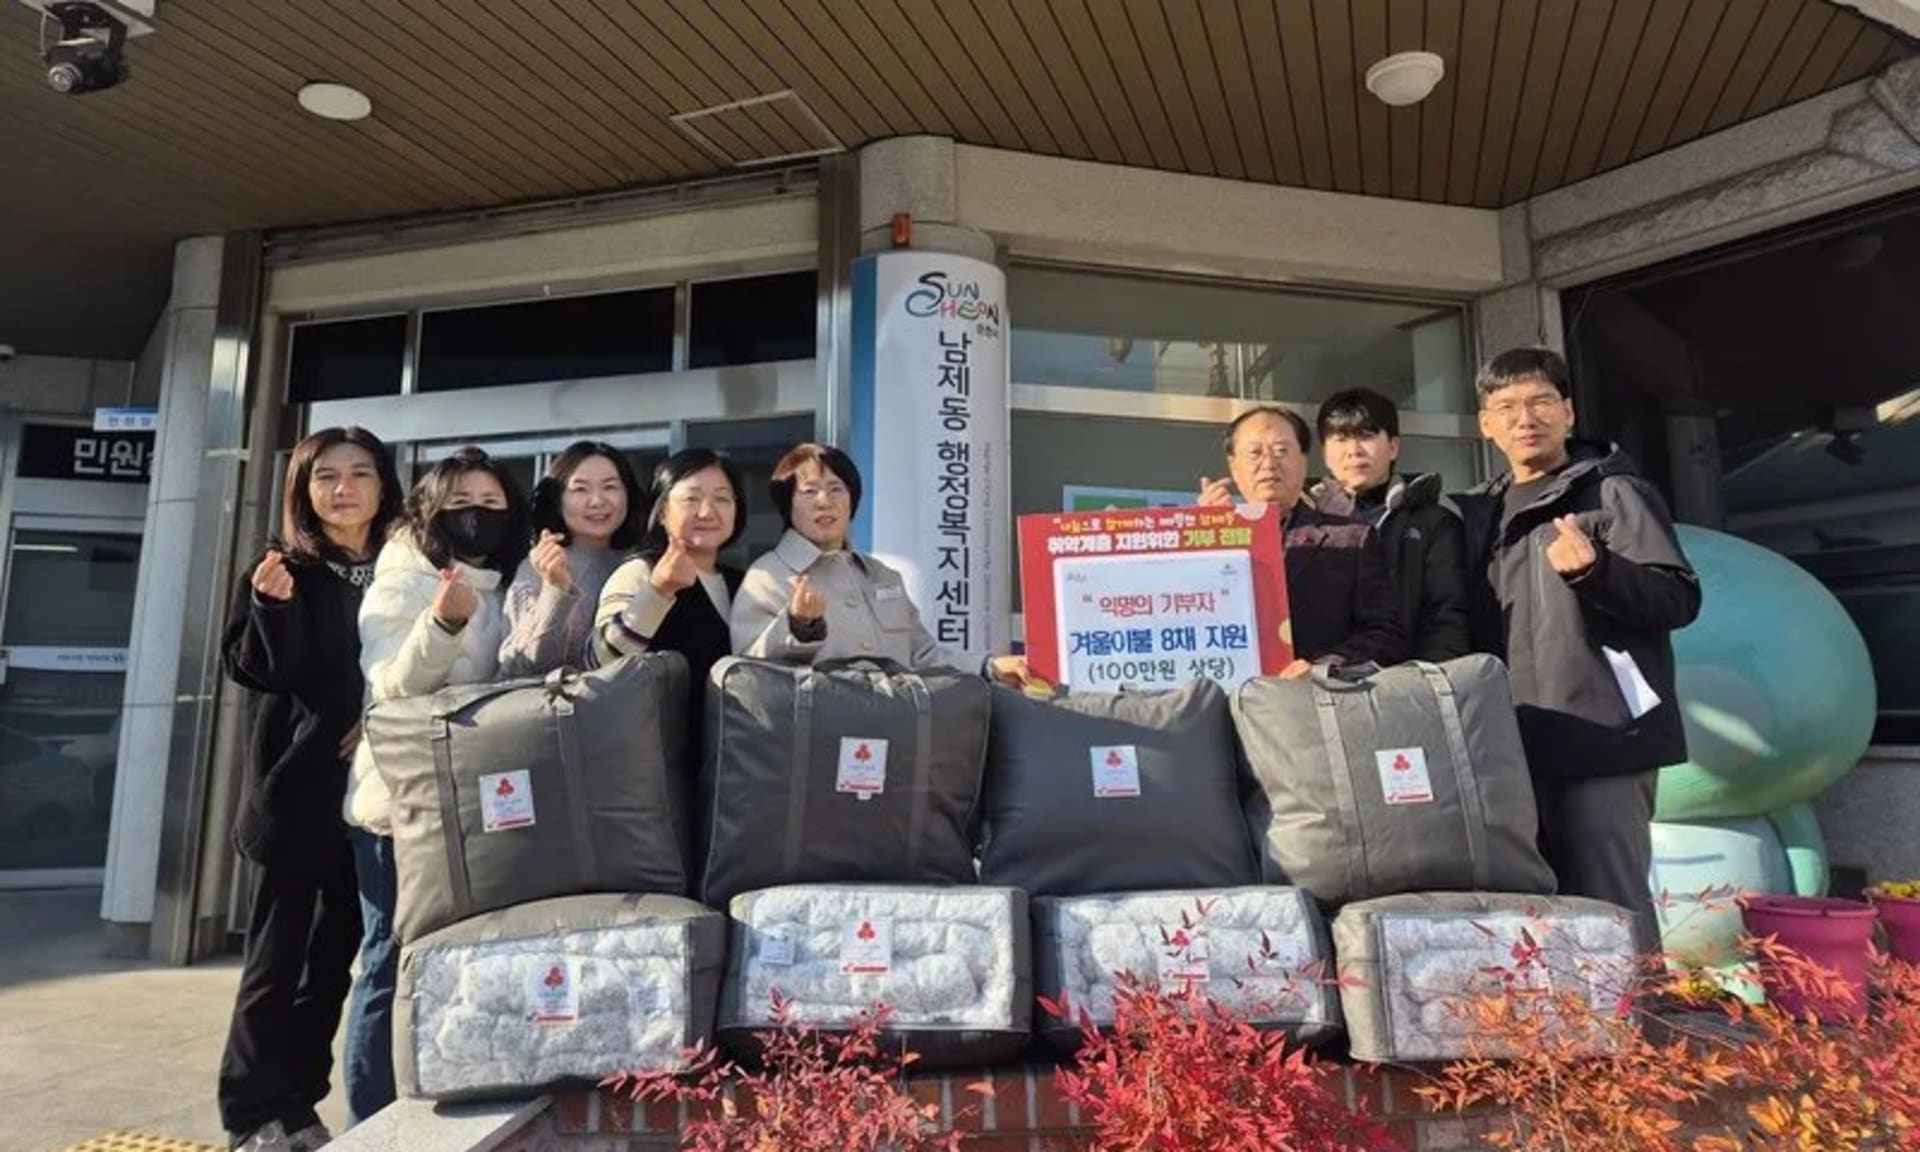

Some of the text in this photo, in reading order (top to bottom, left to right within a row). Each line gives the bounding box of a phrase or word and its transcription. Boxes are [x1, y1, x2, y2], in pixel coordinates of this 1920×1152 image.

[918, 271, 980, 310] SUN
[74, 439, 154, 476] 민원
[936, 330, 973, 651] 남제동 행정복지센터
[1183, 529, 1216, 547] 기부
[1100, 594, 1153, 618] 익명의
[1160, 592, 1216, 615] 기부자
[1070, 624, 1249, 656] 겨울이불 8채 지원
[1088, 656, 1236, 685] (100만원 상당)
